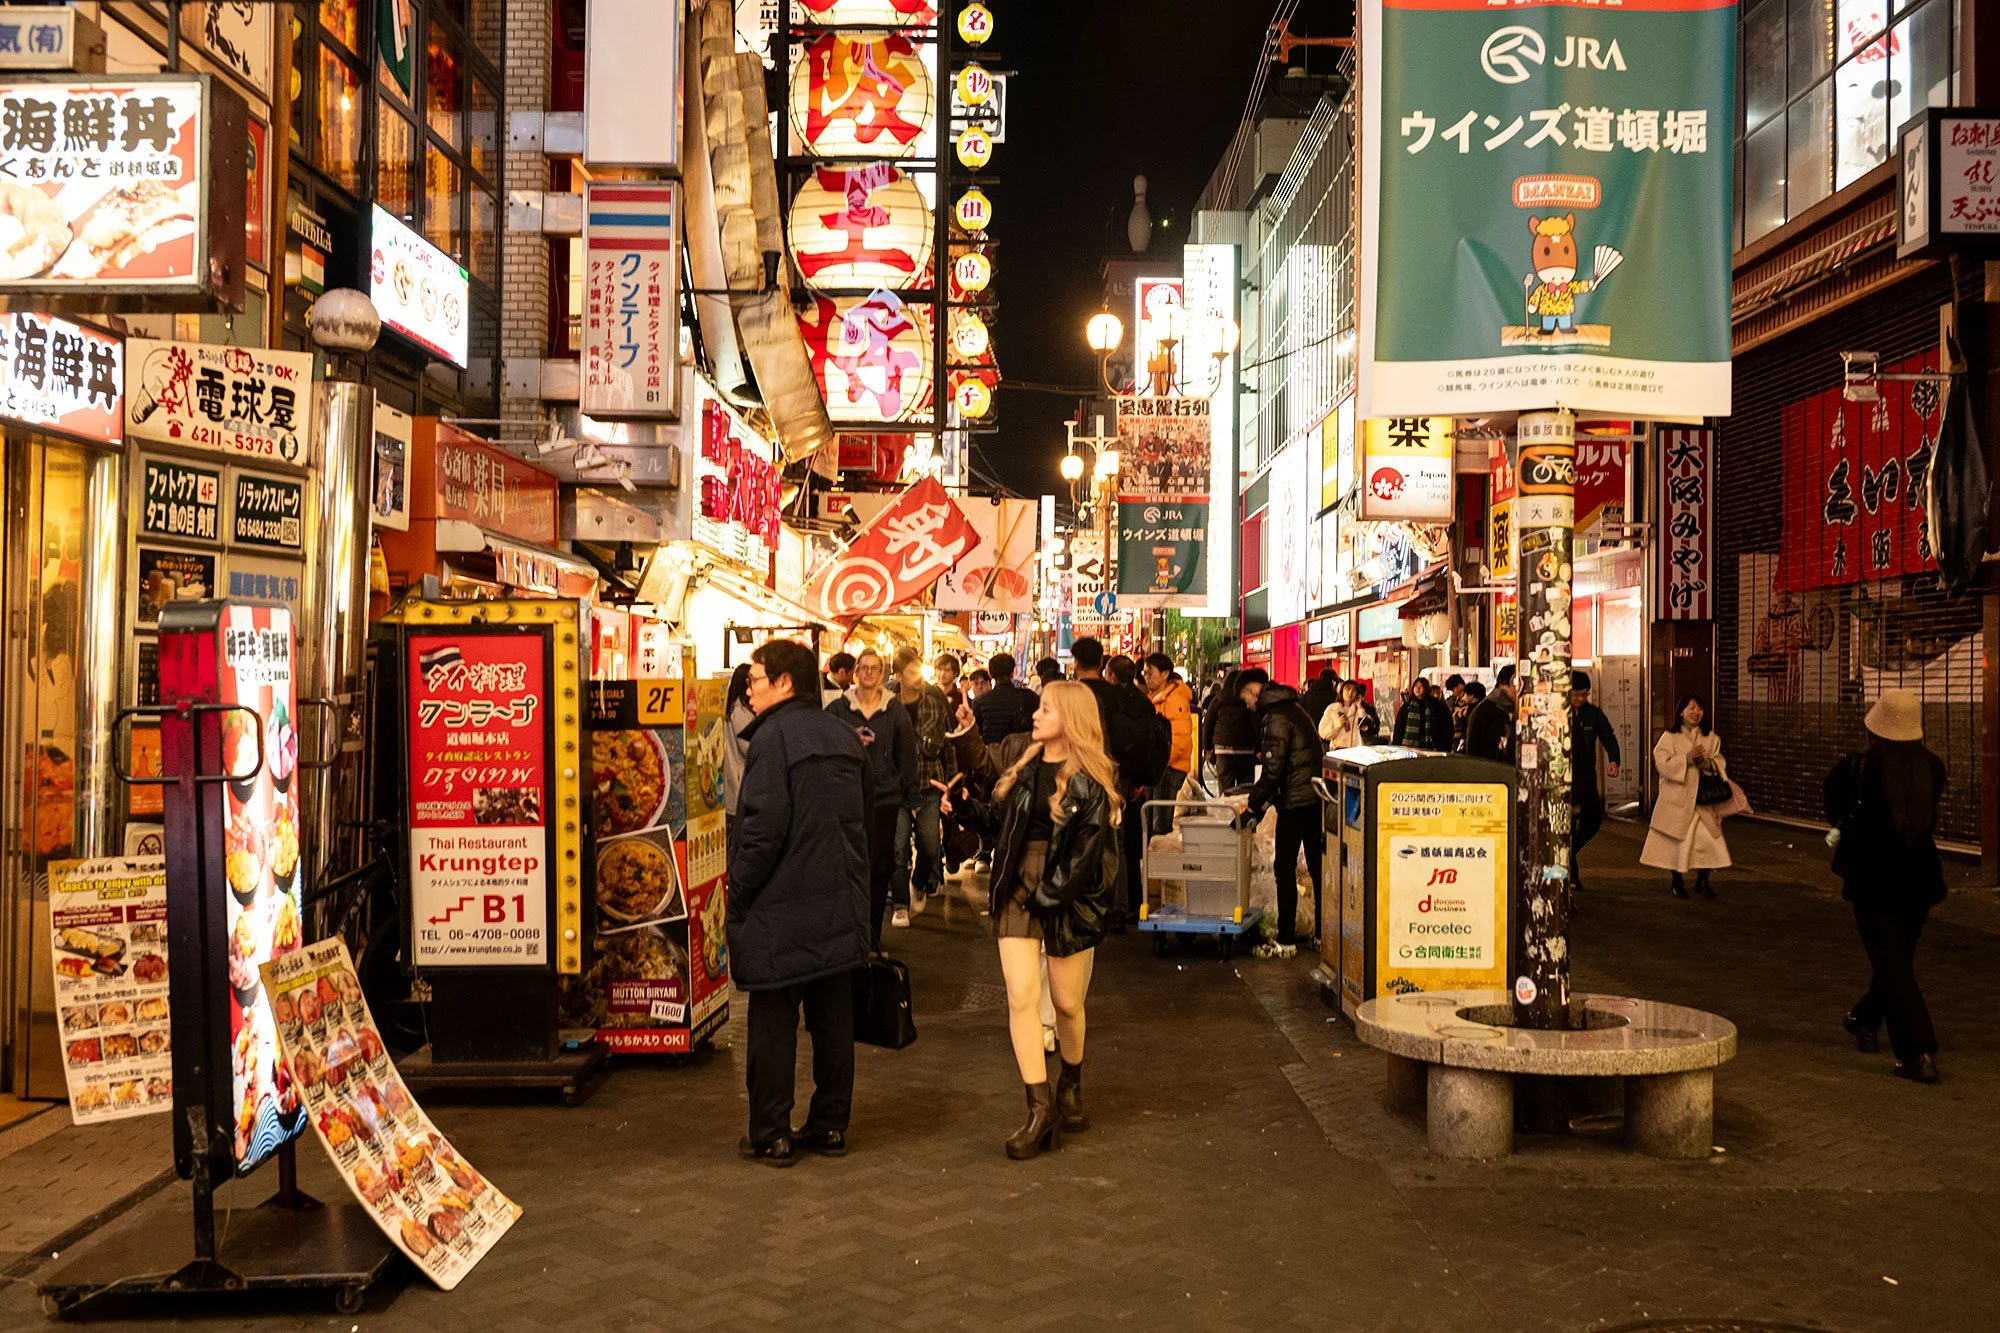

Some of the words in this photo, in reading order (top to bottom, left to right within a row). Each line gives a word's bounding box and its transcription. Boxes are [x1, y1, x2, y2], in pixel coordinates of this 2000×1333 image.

[1554, 36, 1628, 72] JRA
[3, 97, 177, 153] 海鮮丼
[1401, 102, 1708, 155] ウインズ道頓堀
[1523, 181, 1593, 200] MANZAI
[619, 254, 641, 369] クンテープ
[604, 260, 615, 386] タイカルチャースクール
[647, 261, 661, 388] タイ料理とタイスキの店
[15, 313, 118, 411] 海鮮丼
[274, 365, 299, 385] OK!
[195, 367, 297, 432] 電球屋
[646, 391, 660, 402] B1
[192, 425, 274, 455] 6211-5373
[148, 467, 197, 500] フットケア
[201, 481, 214, 500] 4F
[473, 452, 506, 525] 薬局
[147, 499, 166, 531] タコ
[1162, 510, 1183, 521] JRA
[1667, 440, 1708, 610] 大阪みやげ
[237, 517, 247, 537] 06
[1123, 527, 1204, 542] ウインズ道頓堀
[428, 662, 527, 693] タイ料理
[646, 687, 674, 713] 2F
[446, 731, 510, 746] 道頓堀本店
[1391, 792, 1494, 804] 2025関西万博に向けて
[1391, 807, 1441, 817] 実証実験中
[428, 837, 455, 850] Thai
[458, 837, 528, 850] Restaurant
[419, 853, 539, 876] Krungtep
[1427, 868, 1458, 886] JTB
[483, 894, 525, 923] B1
[1433, 898, 1466, 906] docomo
[1433, 905, 1467, 913] business
[420, 929, 441, 941] TEL
[1409, 922, 1472, 935] Forcetec
[420, 945, 523, 955] http://www.krungtep.co.jp
[1415, 945, 1469, 959] 合同衛生
[612, 986, 646, 999] MUTTON
[646, 986, 677, 999] BIRYANI
[654, 1004, 682, 1018] ¥1600
[663, 1033, 685, 1046] OK!
